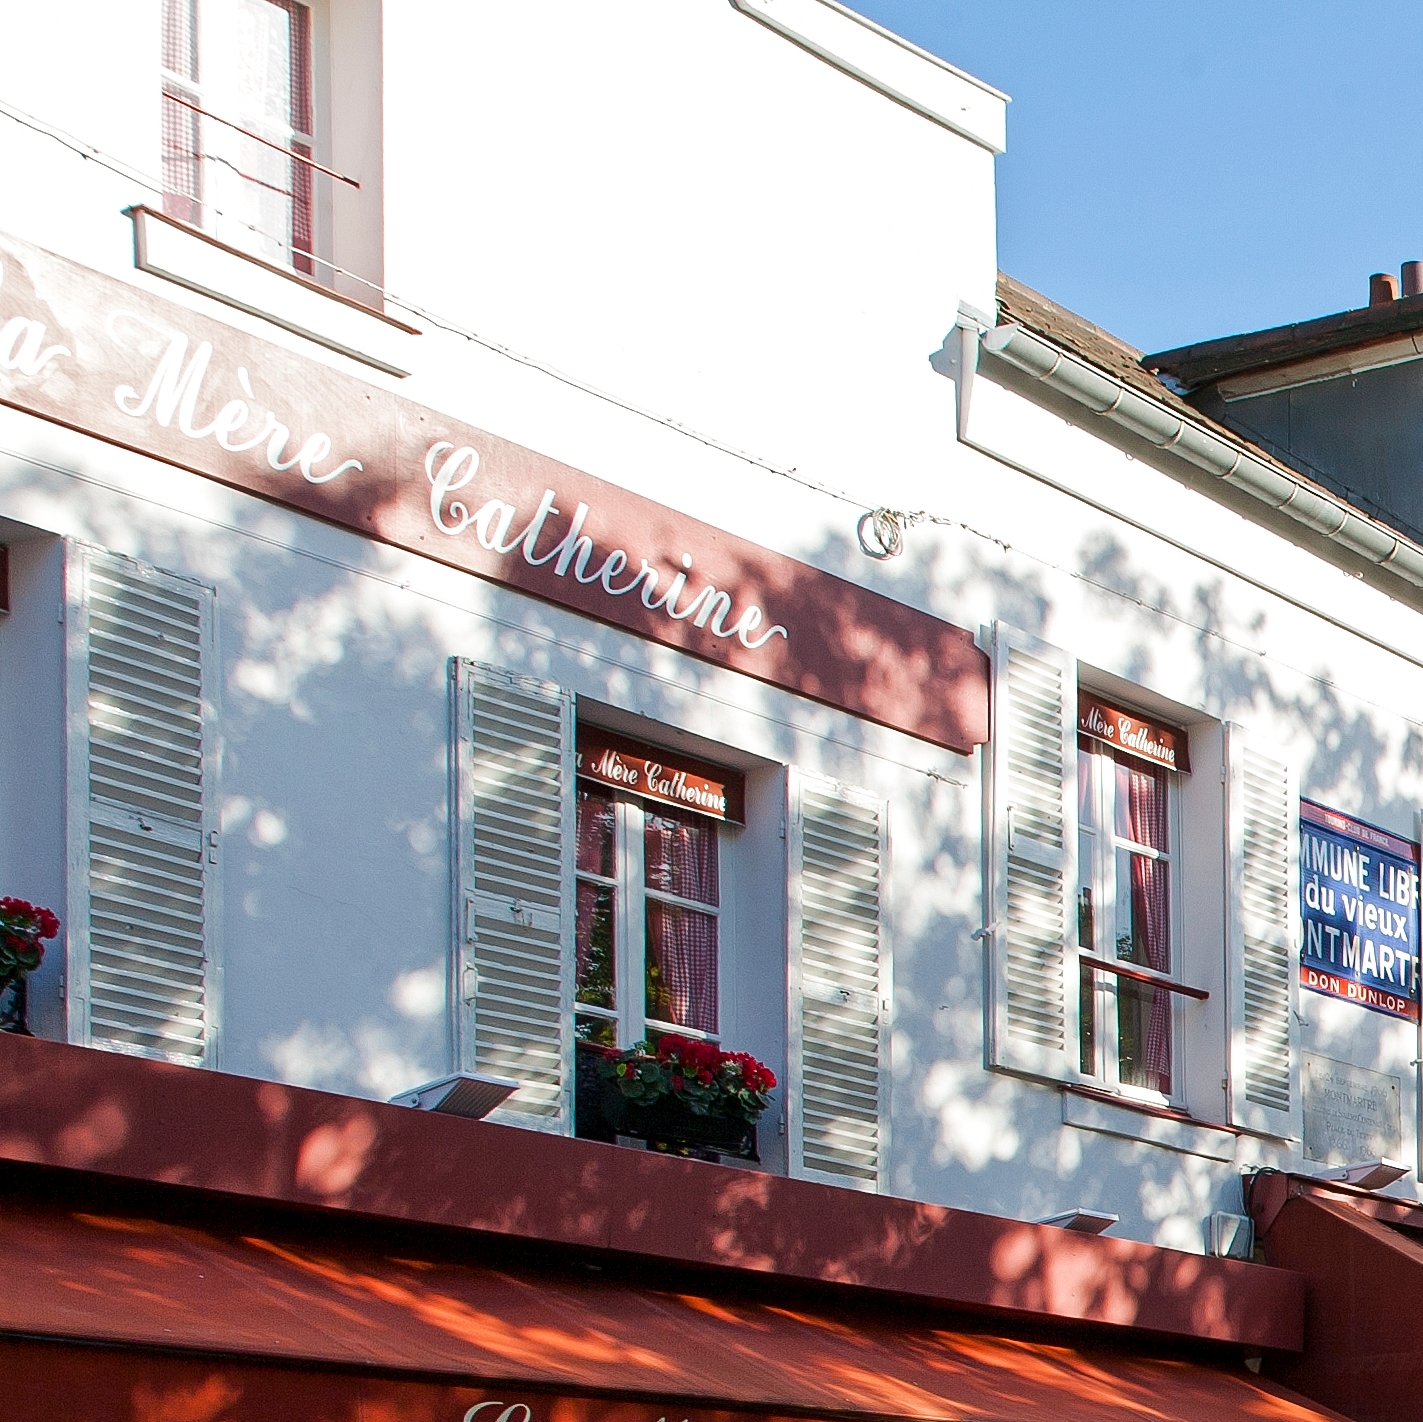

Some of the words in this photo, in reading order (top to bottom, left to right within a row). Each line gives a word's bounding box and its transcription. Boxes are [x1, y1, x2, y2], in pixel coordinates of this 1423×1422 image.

[0, 316, 72, 376] a
[105, 309, 363, 486] Mère
[424, 440, 788, 651] Catherine
[1081, 706, 1115, 738] Mère
[1118, 717, 1175, 762] Catherine
[591, 749, 638, 785] Mère
[644, 760, 726, 812] Catherine
[1370, 830, 1389, 847] FRANCE
[1305, 874, 1336, 916] du
[1341, 890, 1408, 943] vieux
[1308, 971, 1340, 993] DON
[1347, 983, 1405, 1012] DUNLOP
[1324, 1088, 1378, 1111] MONTMARTRE
